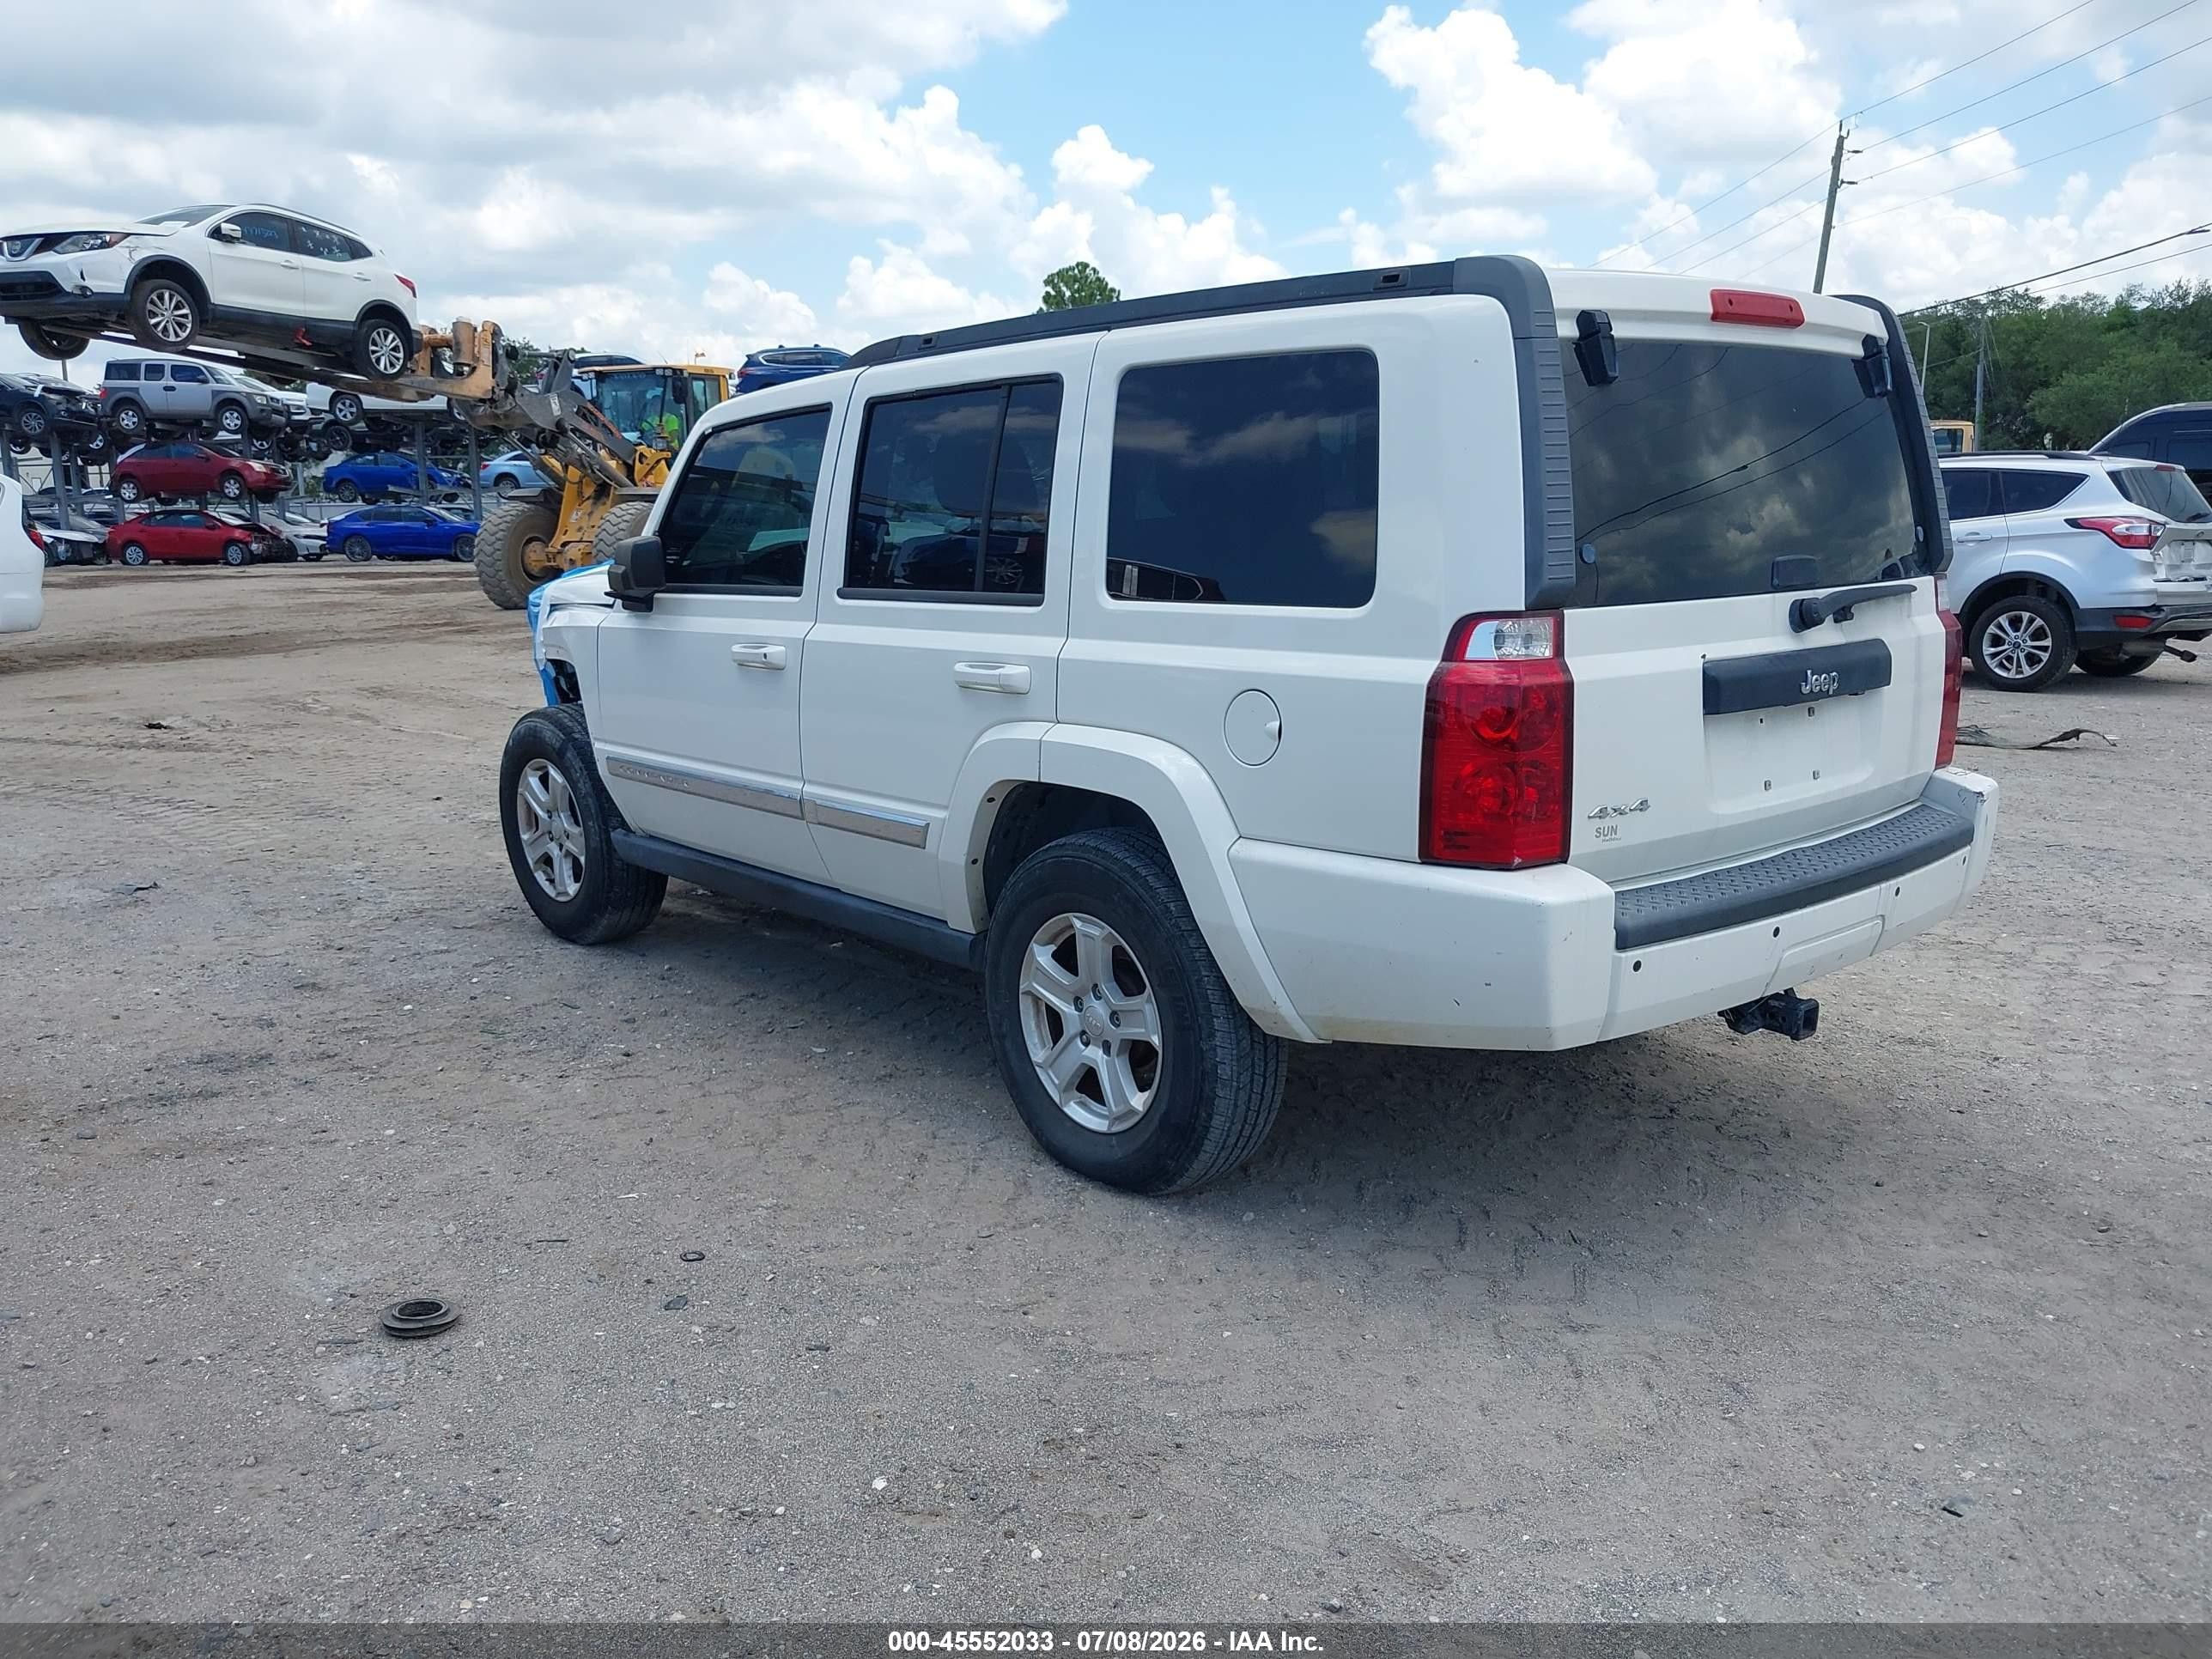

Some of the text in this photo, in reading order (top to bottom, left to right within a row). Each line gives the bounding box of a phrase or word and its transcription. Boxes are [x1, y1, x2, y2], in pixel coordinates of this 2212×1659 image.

[1800, 669, 1839, 695] Jeep
[618, 764, 690, 787] COMMNDR
[1587, 798, 1650, 819] 4x4
[1594, 823, 1619, 839] SUN
